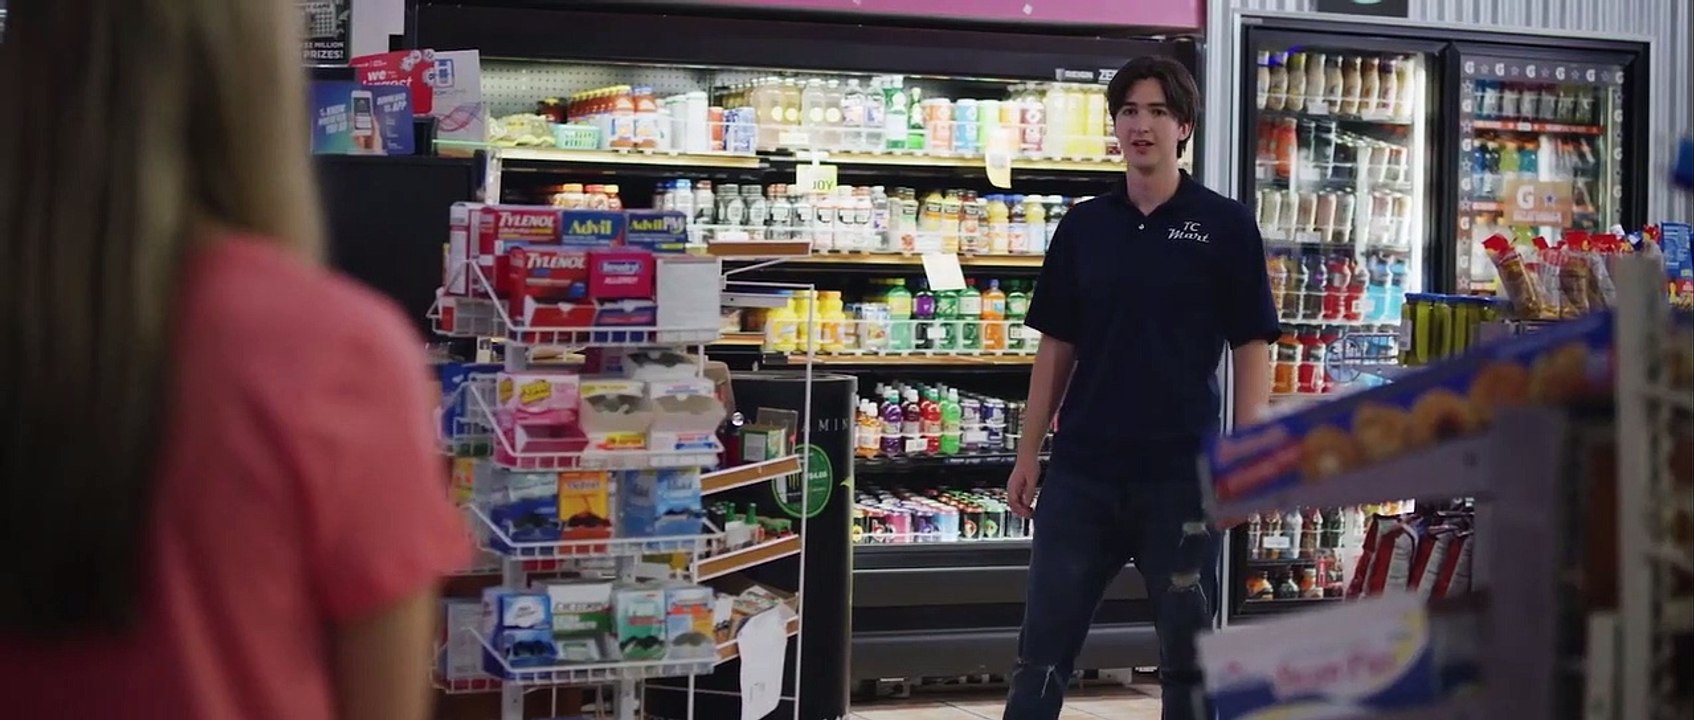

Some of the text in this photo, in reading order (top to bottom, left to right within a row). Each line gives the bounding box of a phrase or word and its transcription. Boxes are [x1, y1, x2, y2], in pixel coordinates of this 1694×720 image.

[303, 50, 344, 59] PRIZES!
[1098, 69, 1118, 81] ZE
[1464, 61, 1624, 84] G G G G G G
[1462, 99, 1472, 112] G
[1614, 109, 1623, 122] G
[1462, 139, 1472, 152] G
[1461, 177, 1471, 190] G
[1517, 185, 1535, 209] G
[498, 212, 555, 228] TYLENOL
[629, 219, 663, 231] Advil
[1183, 221, 1201, 232] TC
[1460, 216, 1470, 229] G
[569, 219, 612, 235] Advil
[1167, 228, 1210, 243] Mart
[525, 253, 585, 269] TYLENOL
